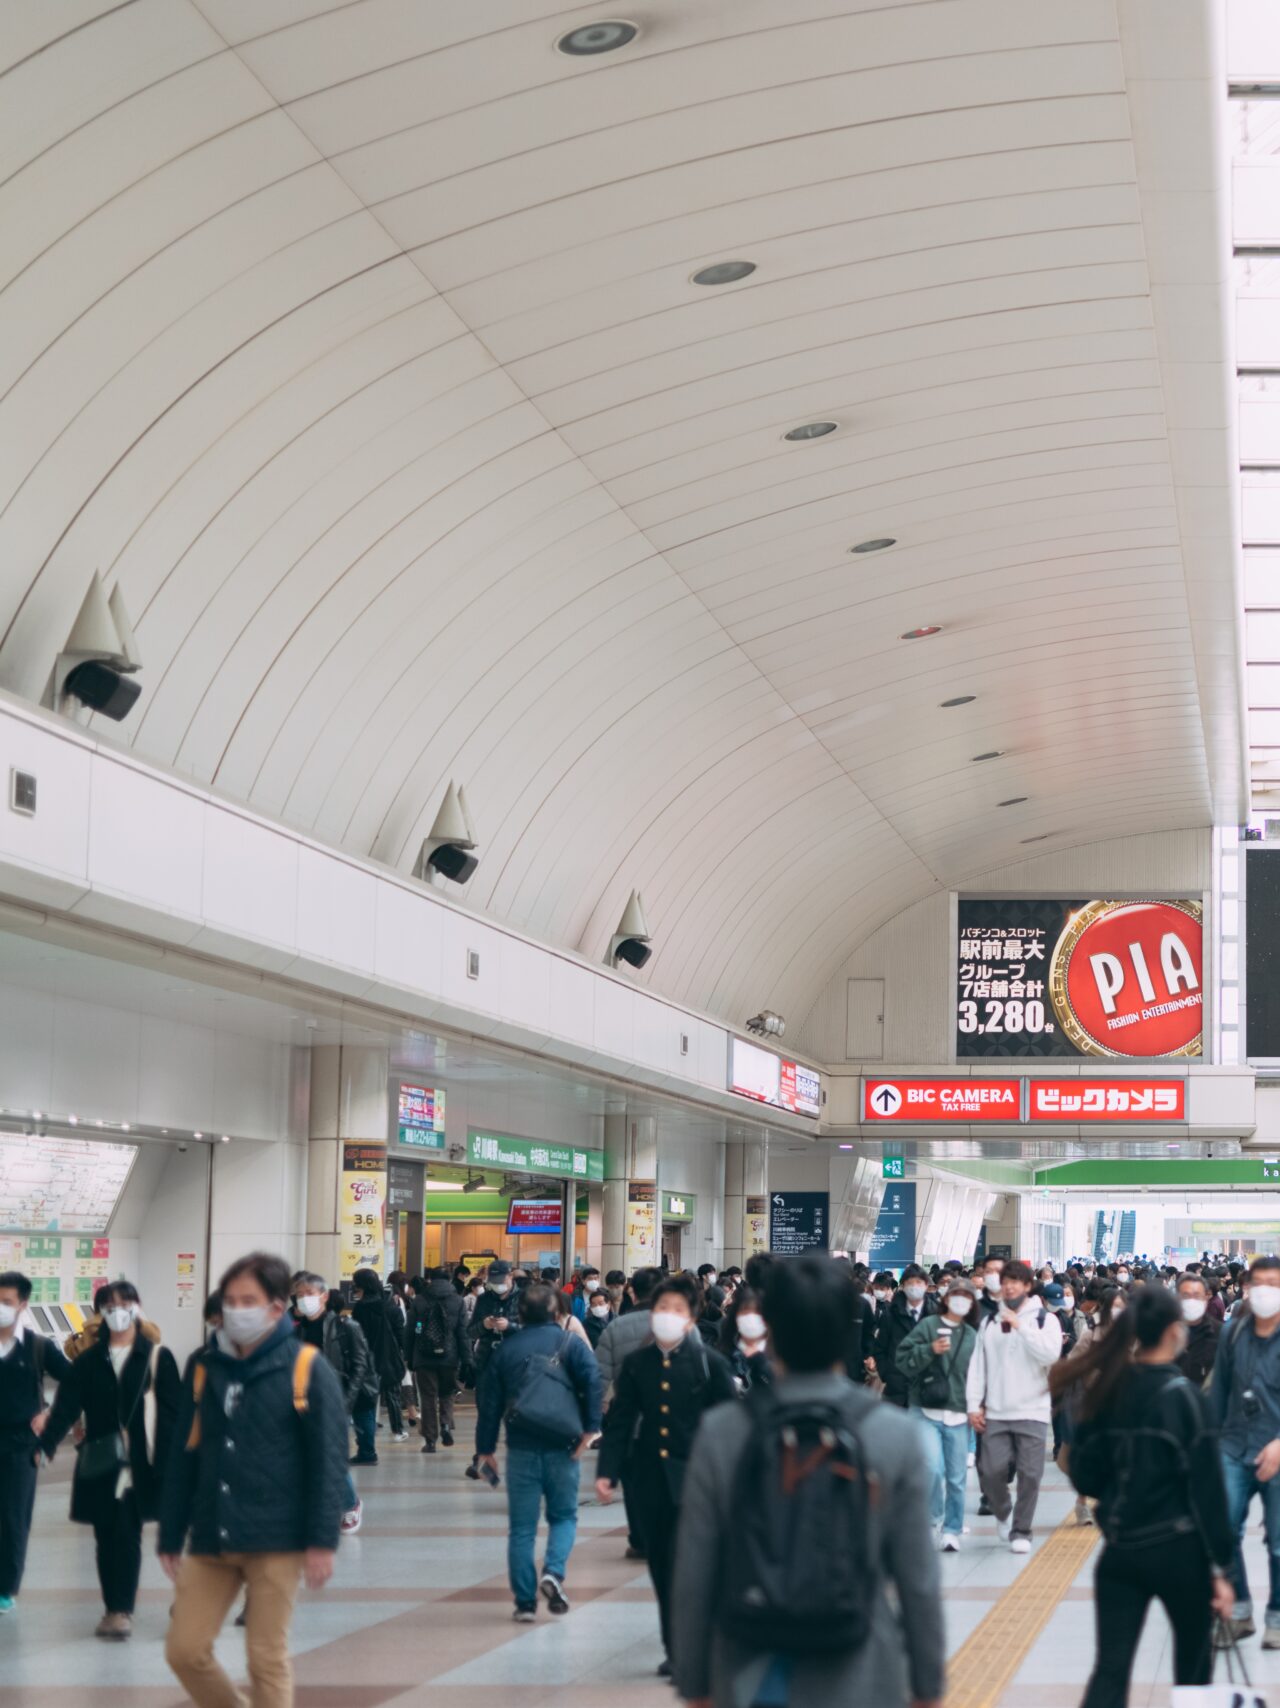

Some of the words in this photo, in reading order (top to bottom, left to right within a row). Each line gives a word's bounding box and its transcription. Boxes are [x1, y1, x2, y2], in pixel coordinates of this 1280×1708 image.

[961, 928, 1046, 938] パチンコ&スロット
[960, 939, 1045, 960] 駅前最大
[959, 963, 1026, 980] グループ
[1089, 932, 1199, 1015] PIA
[959, 980, 1044, 998] 7店舗合計
[1107, 1012, 1140, 1030] FASHION
[907, 1088, 936, 1103] BIC
[939, 1088, 1014, 1103] CAMERA
[1036, 1088, 1177, 1112] ビックカメラ
[941, 1103, 959, 1111] TAX
[960, 1103, 980, 1111] FREE
[353, 1214, 374, 1225] 3.6
[353, 1234, 373, 1245] 3.7
